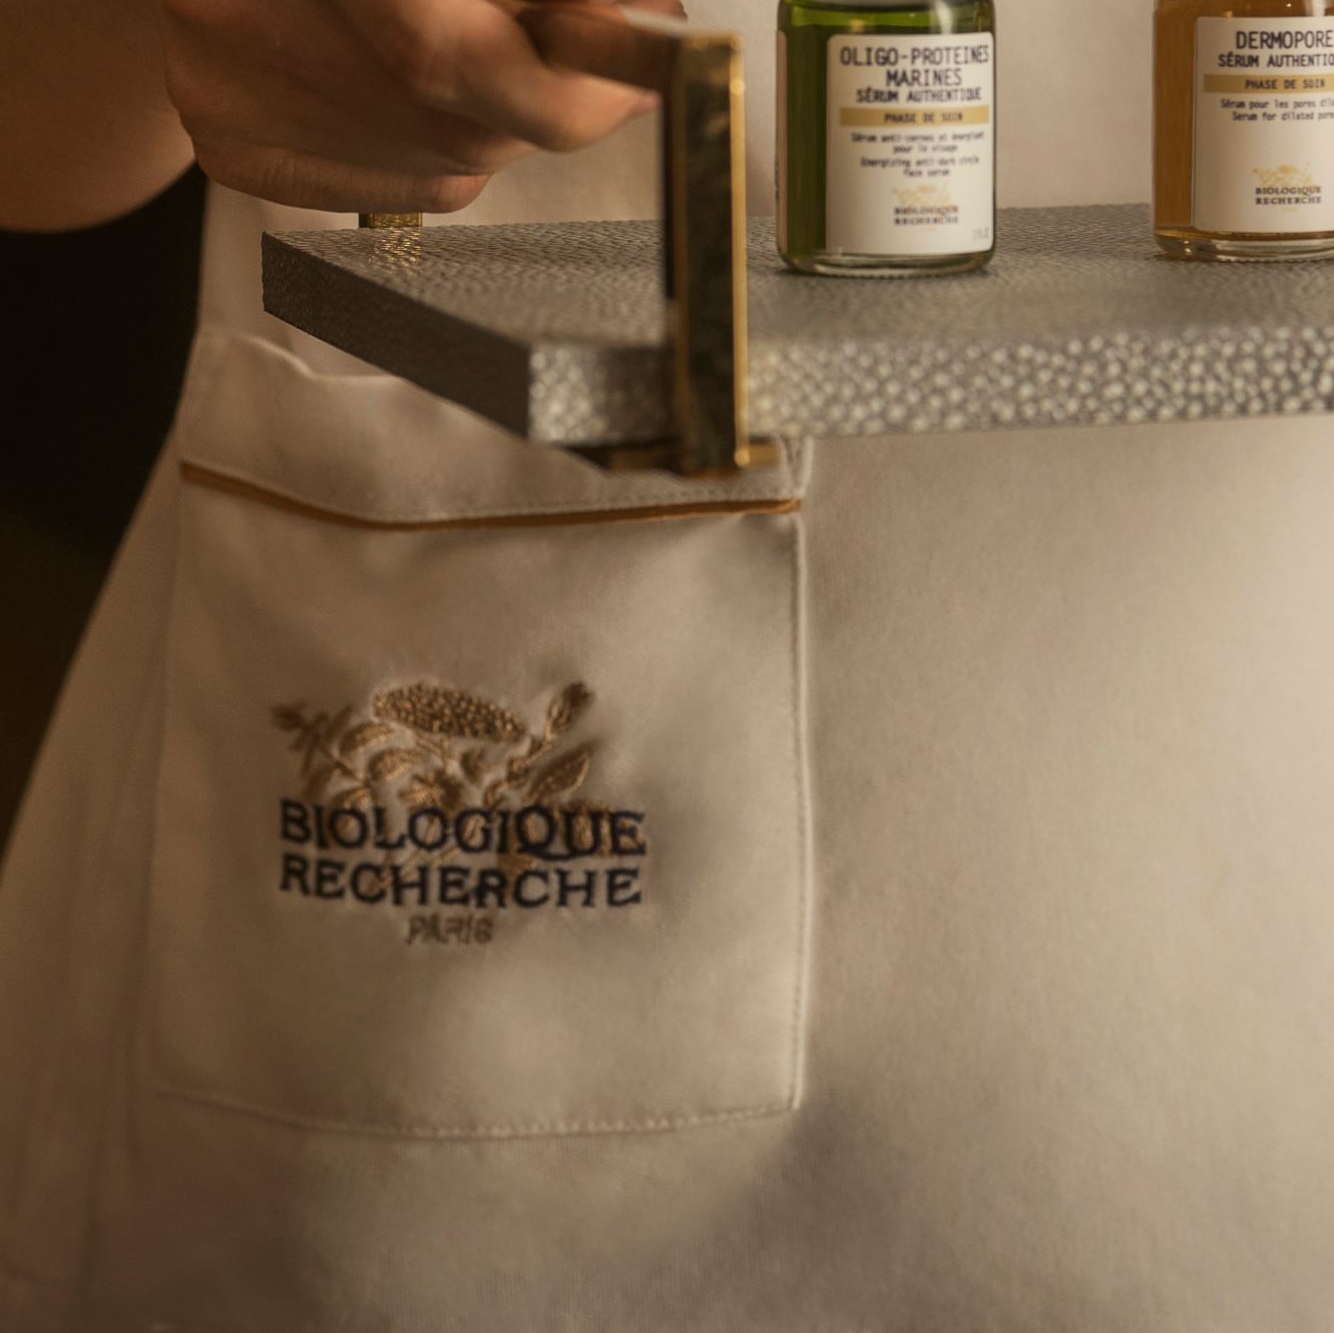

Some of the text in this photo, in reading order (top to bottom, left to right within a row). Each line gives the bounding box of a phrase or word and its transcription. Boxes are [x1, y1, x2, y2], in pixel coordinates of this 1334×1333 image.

[1236, 30, 1333, 49] DERMOPORE
[840, 45, 989, 66] OLIGO-PROTEINES
[1218, 51, 1259, 67] SÉRUM
[886, 69, 962, 86] MARINES
[1245, 79, 1325, 89] PHASE DE SOIN
[857, 87, 981, 103] SÉRUM AUTHENTIQUE
[1221, 99, 1245, 108] Sérum
[1249, 100, 1269, 109] pour
[1275, 100, 1288, 108] les
[1294, 100, 1315, 109] pores
[1233, 112, 1257, 121] Serum
[1263, 112, 1276, 120] for
[1282, 111, 1313, 120] dilated
[1256, 186, 1321, 196] BIOLOGIQUE
[1256, 197, 1322, 205] RECHERCHE
[279, 798, 646, 861] BIOLOGIQUE
[279, 853, 641, 908] RECHERCHE
[405, 913, 494, 945] PARIS
